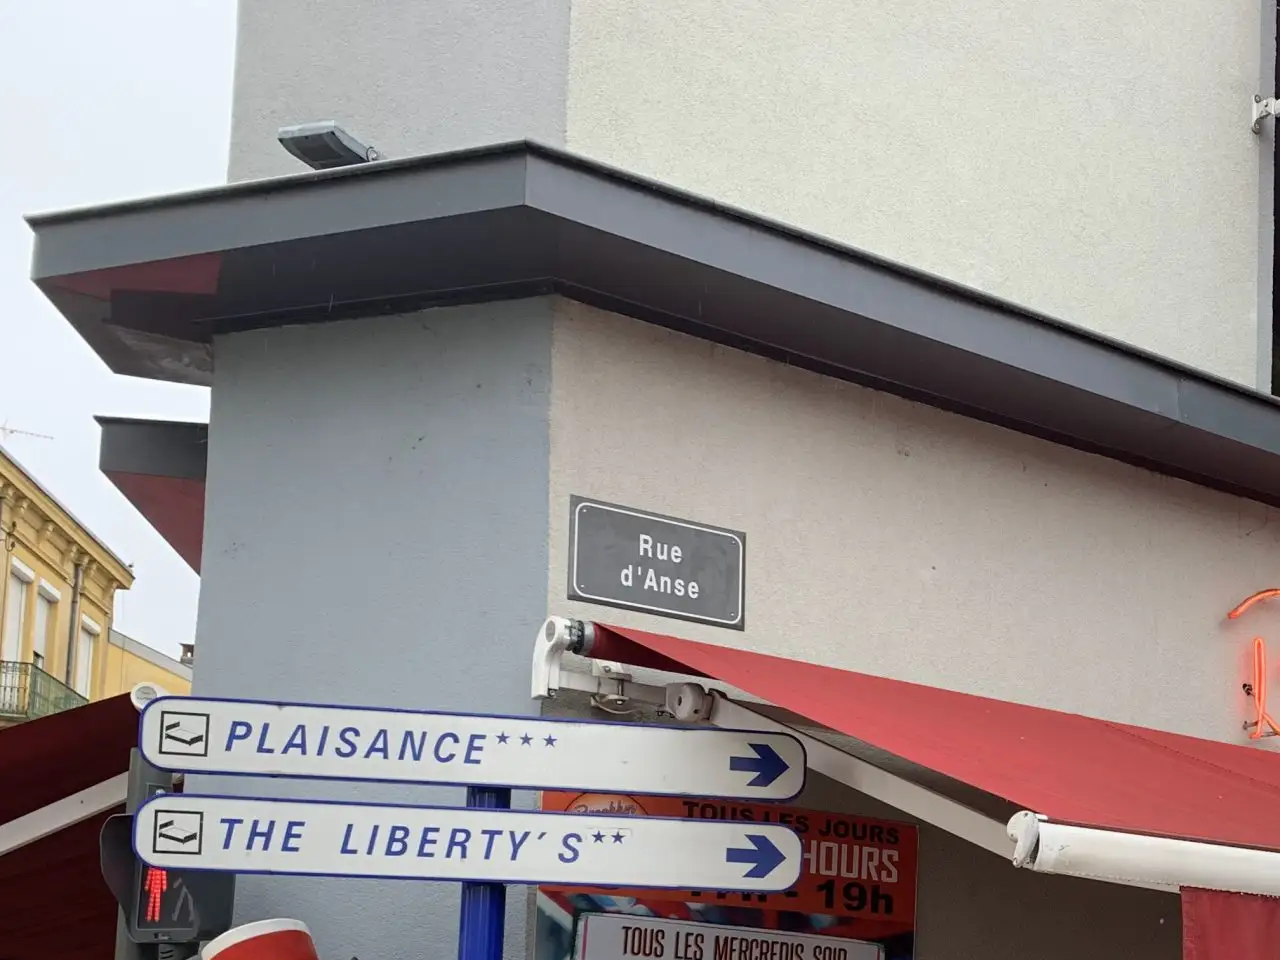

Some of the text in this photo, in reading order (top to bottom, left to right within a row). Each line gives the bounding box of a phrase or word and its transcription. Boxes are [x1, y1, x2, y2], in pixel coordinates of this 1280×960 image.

[639, 533, 682, 563] Rue
[620, 564, 699, 599] d'Anse
[224, 721, 487, 765] PLAISANCE
[220, 818, 303, 852] THE
[819, 820, 900, 845] JOURS
[816, 879, 893, 915] 19h
[622, 926, 665, 957] TOUS
